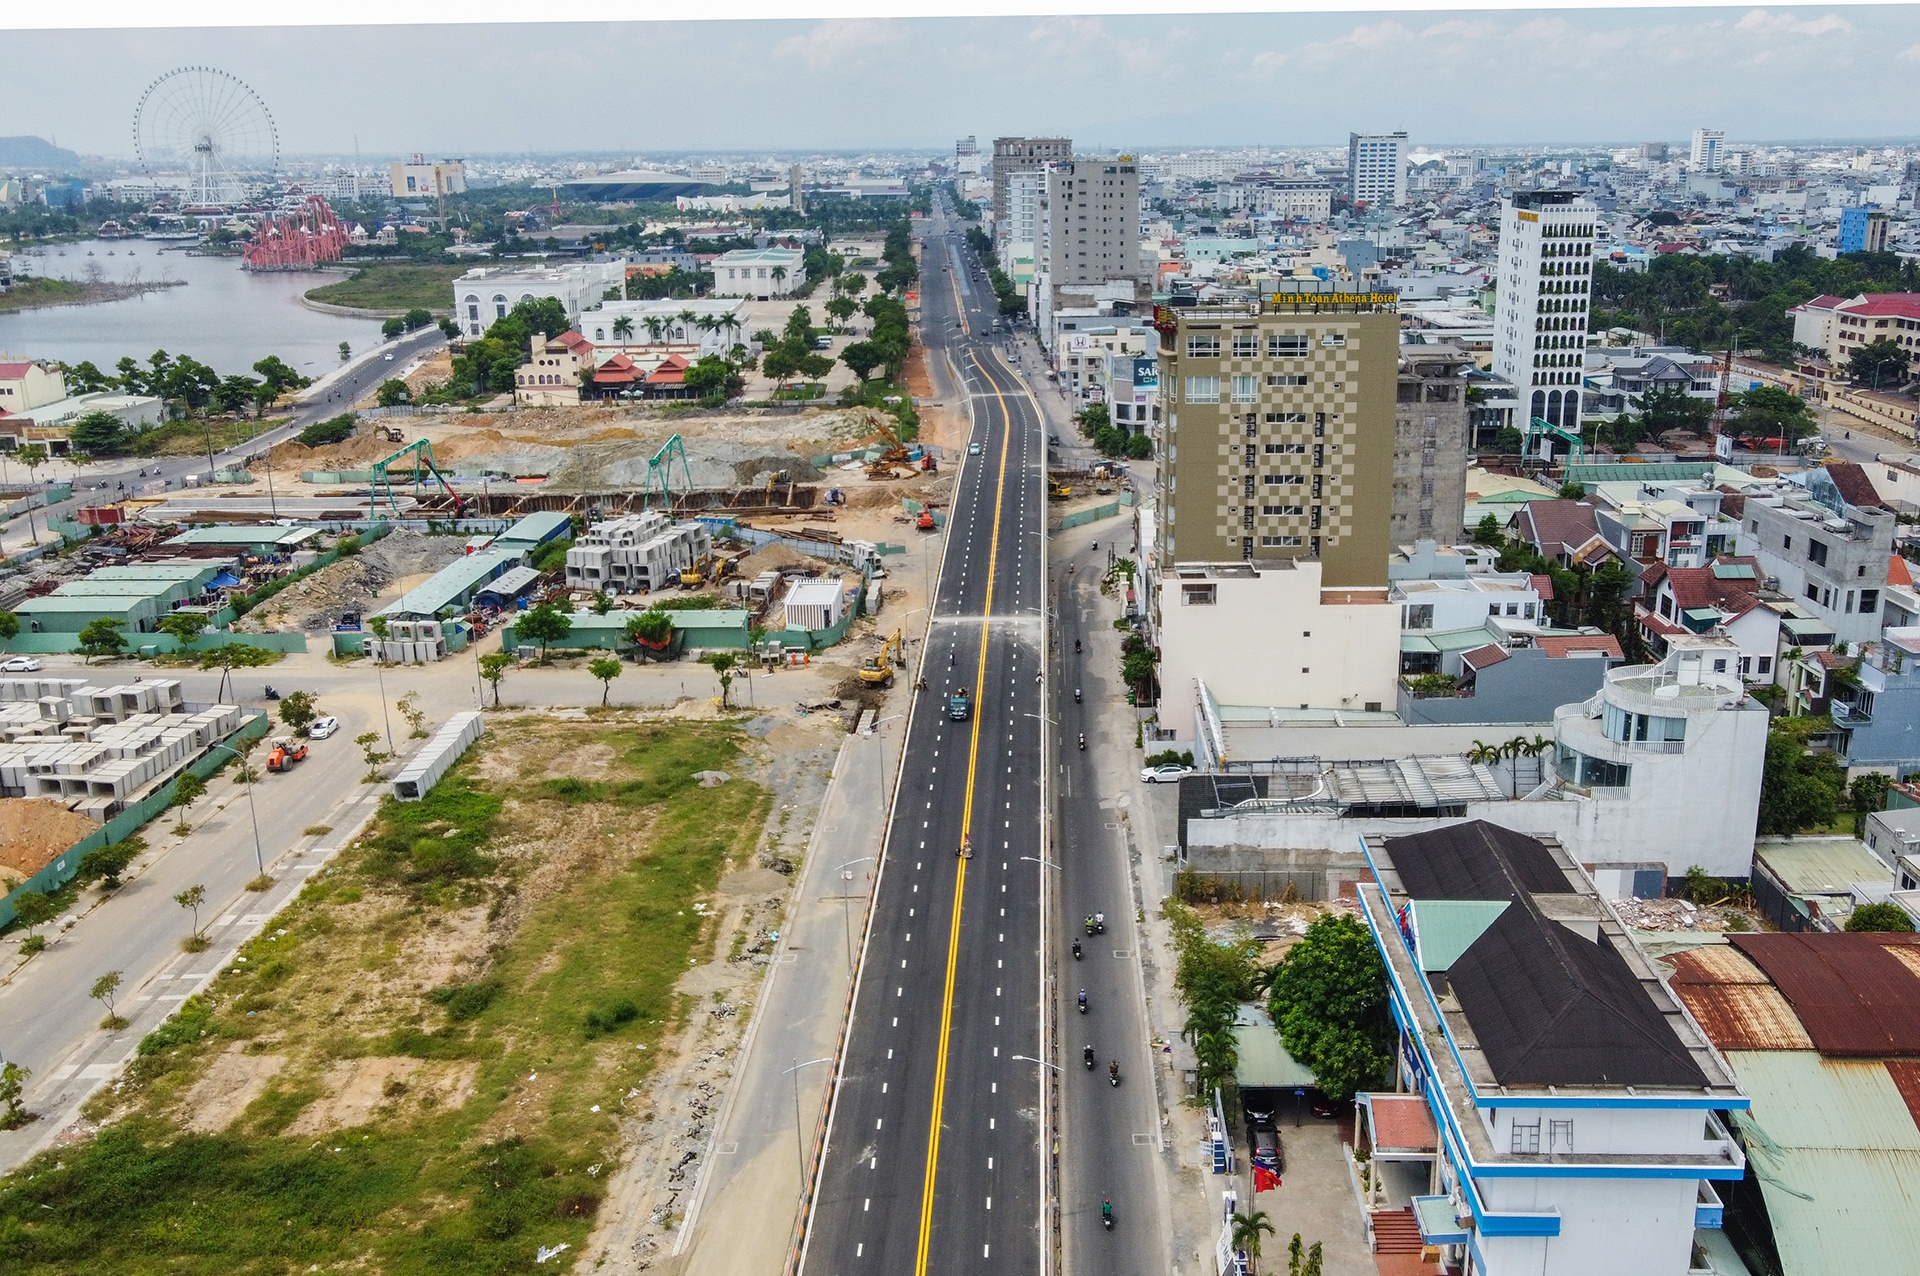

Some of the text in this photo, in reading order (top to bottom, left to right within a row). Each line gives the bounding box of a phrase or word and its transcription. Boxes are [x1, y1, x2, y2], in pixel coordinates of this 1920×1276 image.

[1272, 292, 1397, 303] Minh Toan Athena Hotel
